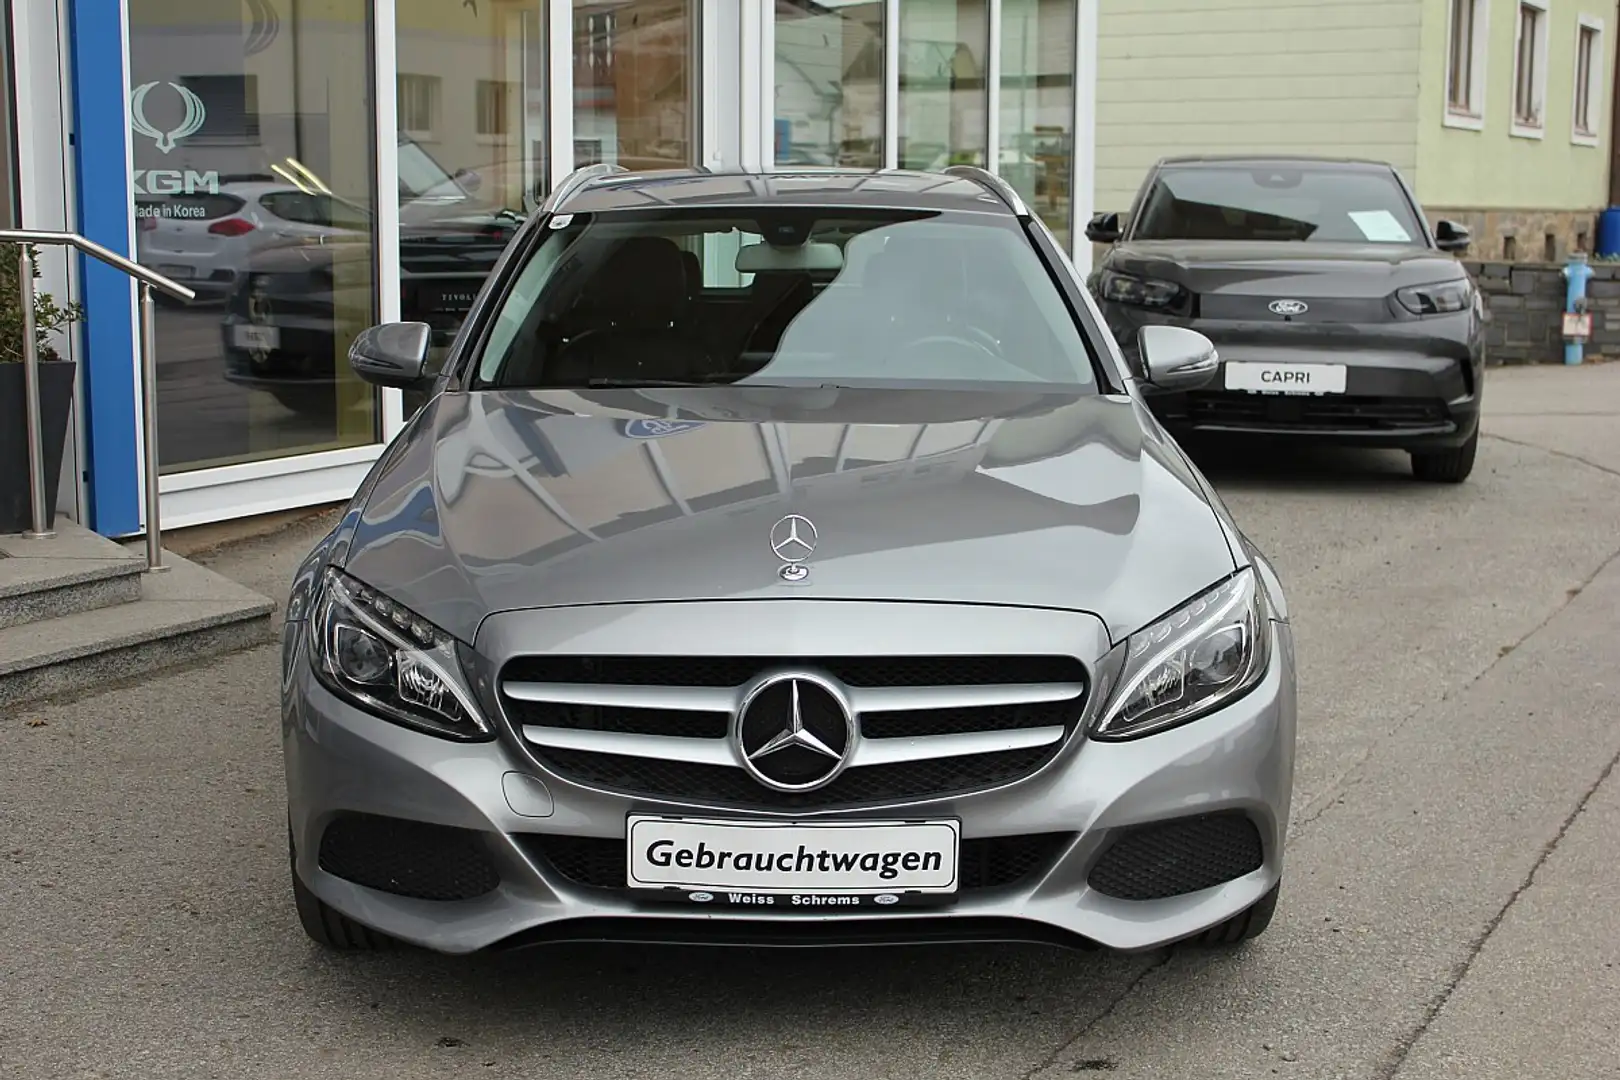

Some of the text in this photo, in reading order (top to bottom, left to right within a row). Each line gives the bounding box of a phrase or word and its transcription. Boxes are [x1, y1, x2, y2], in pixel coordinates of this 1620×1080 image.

[162, 204, 171, 217] in
[174, 205, 206, 217] Korea
[1261, 371, 1310, 384] CAPRI
[646, 840, 942, 879] Gebrauchtwagen
[728, 893, 774, 904] Weiss
[791, 894, 860, 905] Schrems
